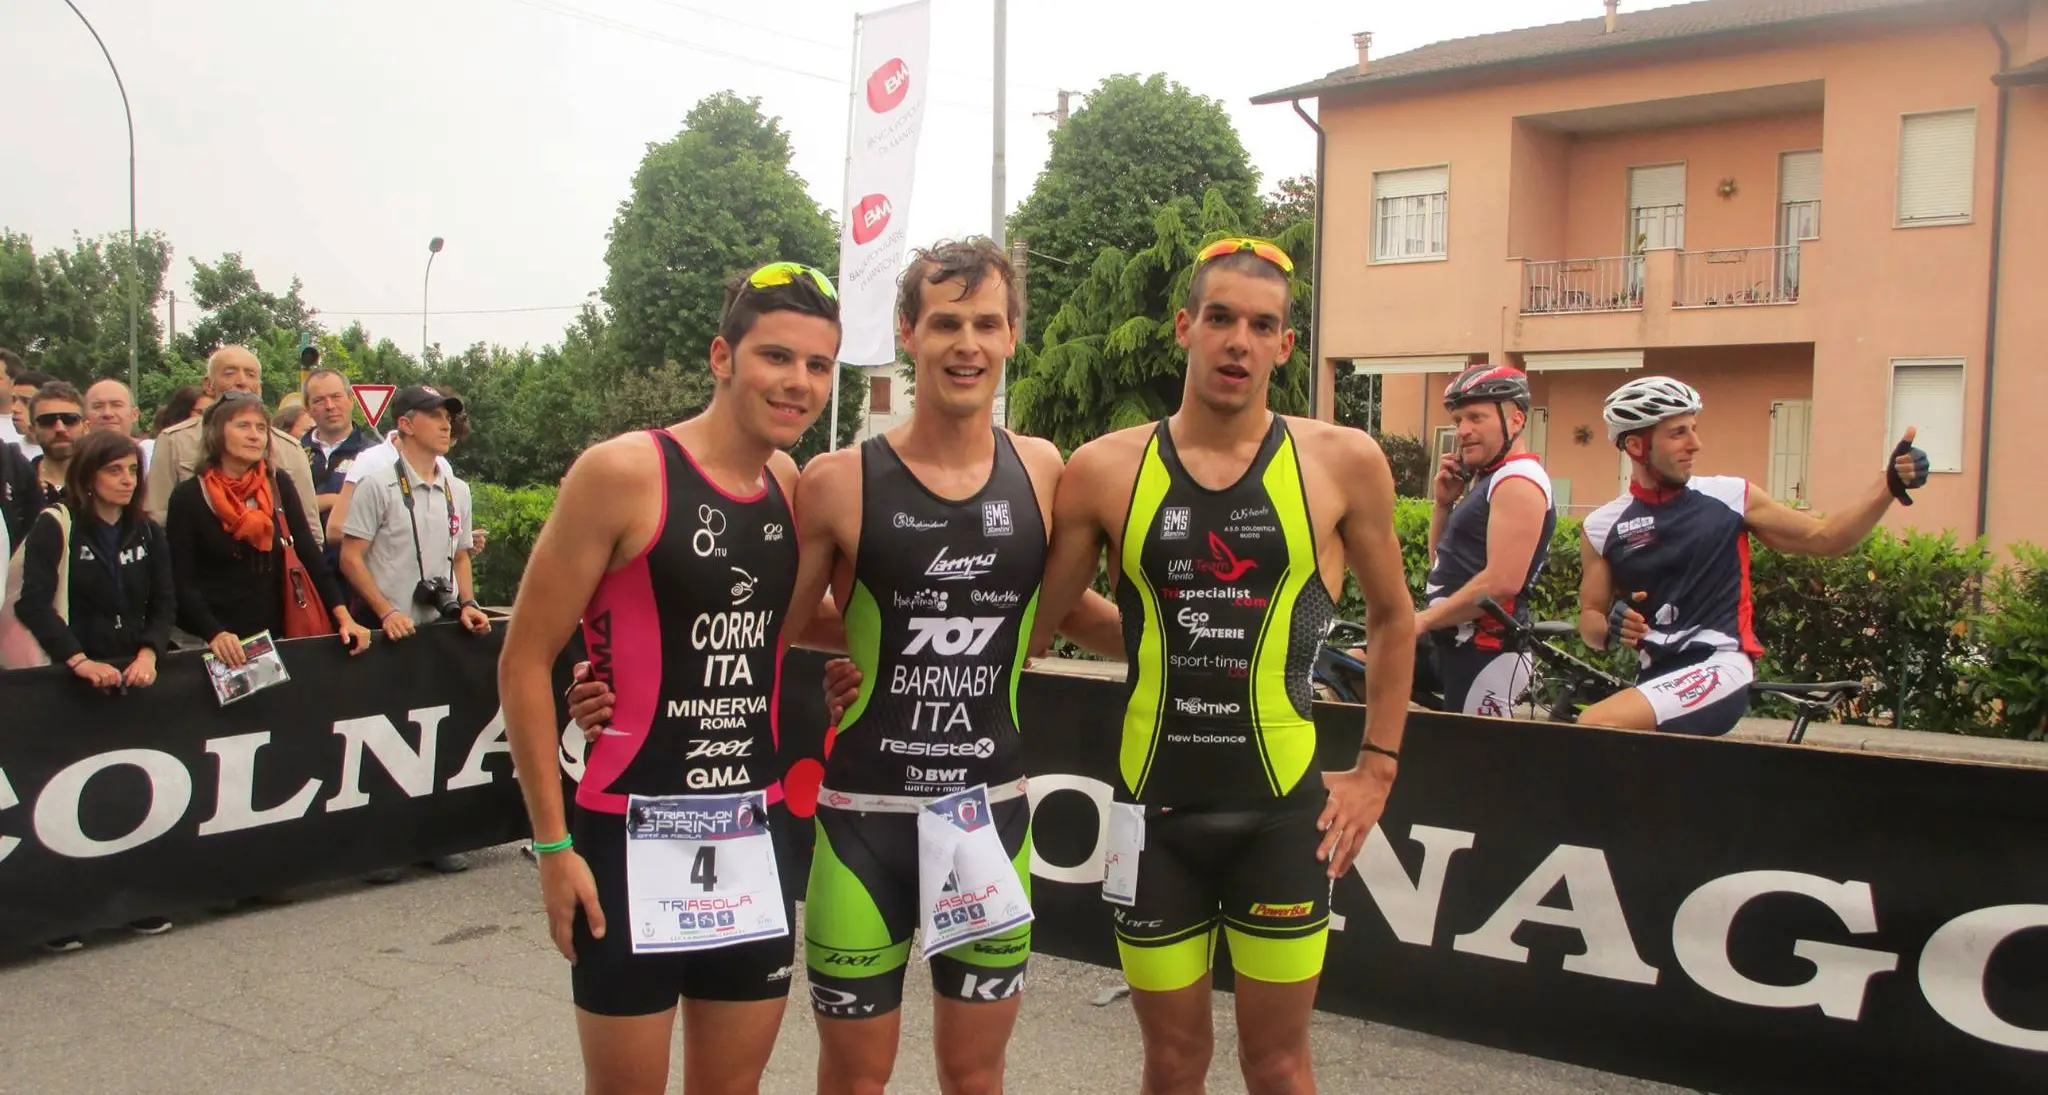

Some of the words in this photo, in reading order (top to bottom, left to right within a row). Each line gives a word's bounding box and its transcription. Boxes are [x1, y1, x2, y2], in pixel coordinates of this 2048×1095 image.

[714, 548, 727, 557] ITU
[691, 610, 773, 650] CORRA'
[901, 616, 1006, 656] 707
[703, 654, 753, 687] ITA
[890, 665, 1002, 697] BARNABY
[667, 696, 767, 717] MINERVA
[1174, 697, 1240, 715] TRENTINO
[700, 717, 746, 730] ROMA
[911, 701, 972, 732] ITA
[1168, 734, 1191, 742] new
[1193, 734, 1246, 743] balance
[925, 768, 967, 781] BWT
[905, 784, 934, 792] water
[654, 810, 732, 820] TRIATHLON
[637, 819, 731, 833] SPRINT
[690, 846, 717, 892] 4
[658, 895, 752, 911] TRIASOLA
